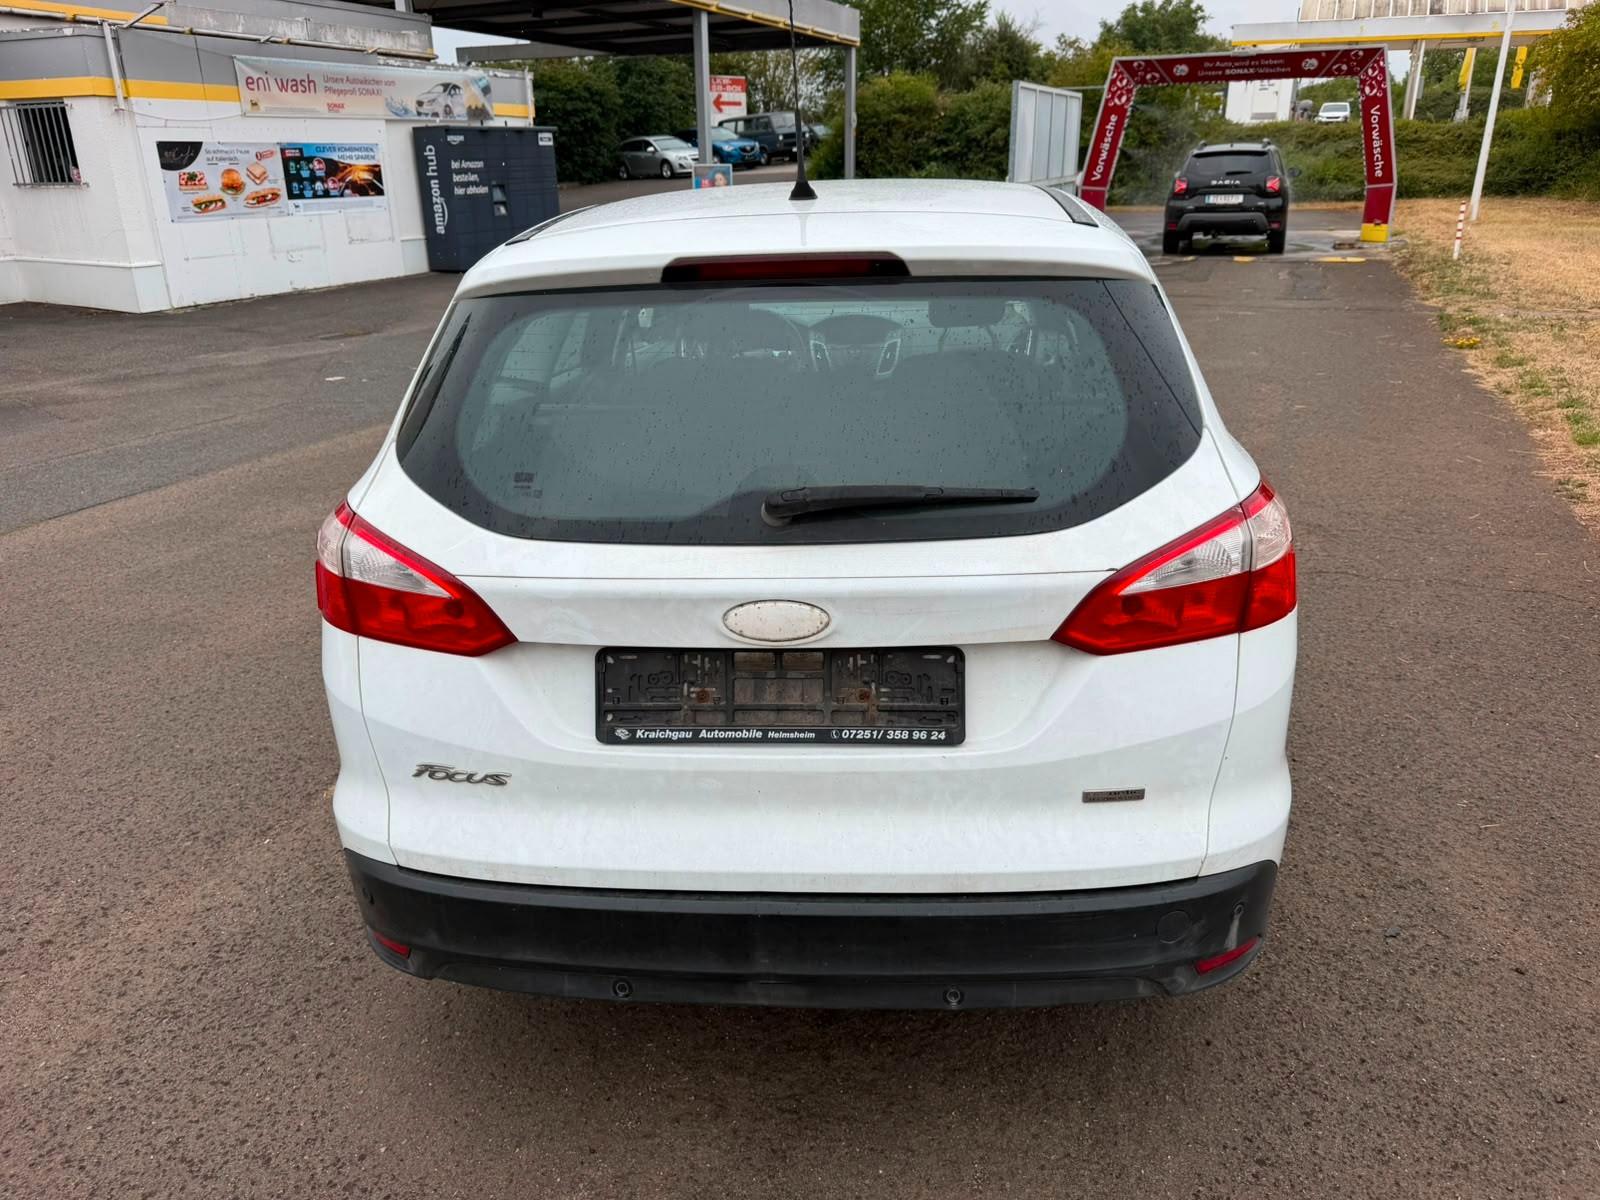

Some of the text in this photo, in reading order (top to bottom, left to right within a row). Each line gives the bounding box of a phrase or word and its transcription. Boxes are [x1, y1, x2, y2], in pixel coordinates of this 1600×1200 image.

[245, 70, 317, 94] eni wash
[323, 73, 344, 84] Unsere
[1091, 114, 1118, 180] Vorwäsche
[1370, 105, 1385, 177] Vorwäsche
[451, 160, 484, 169] bei Amazon
[424, 144, 447, 235] amazon hub
[636, 729, 946, 740] Kraichgau Automobile Helmsheim 07251/ 358 96 24
